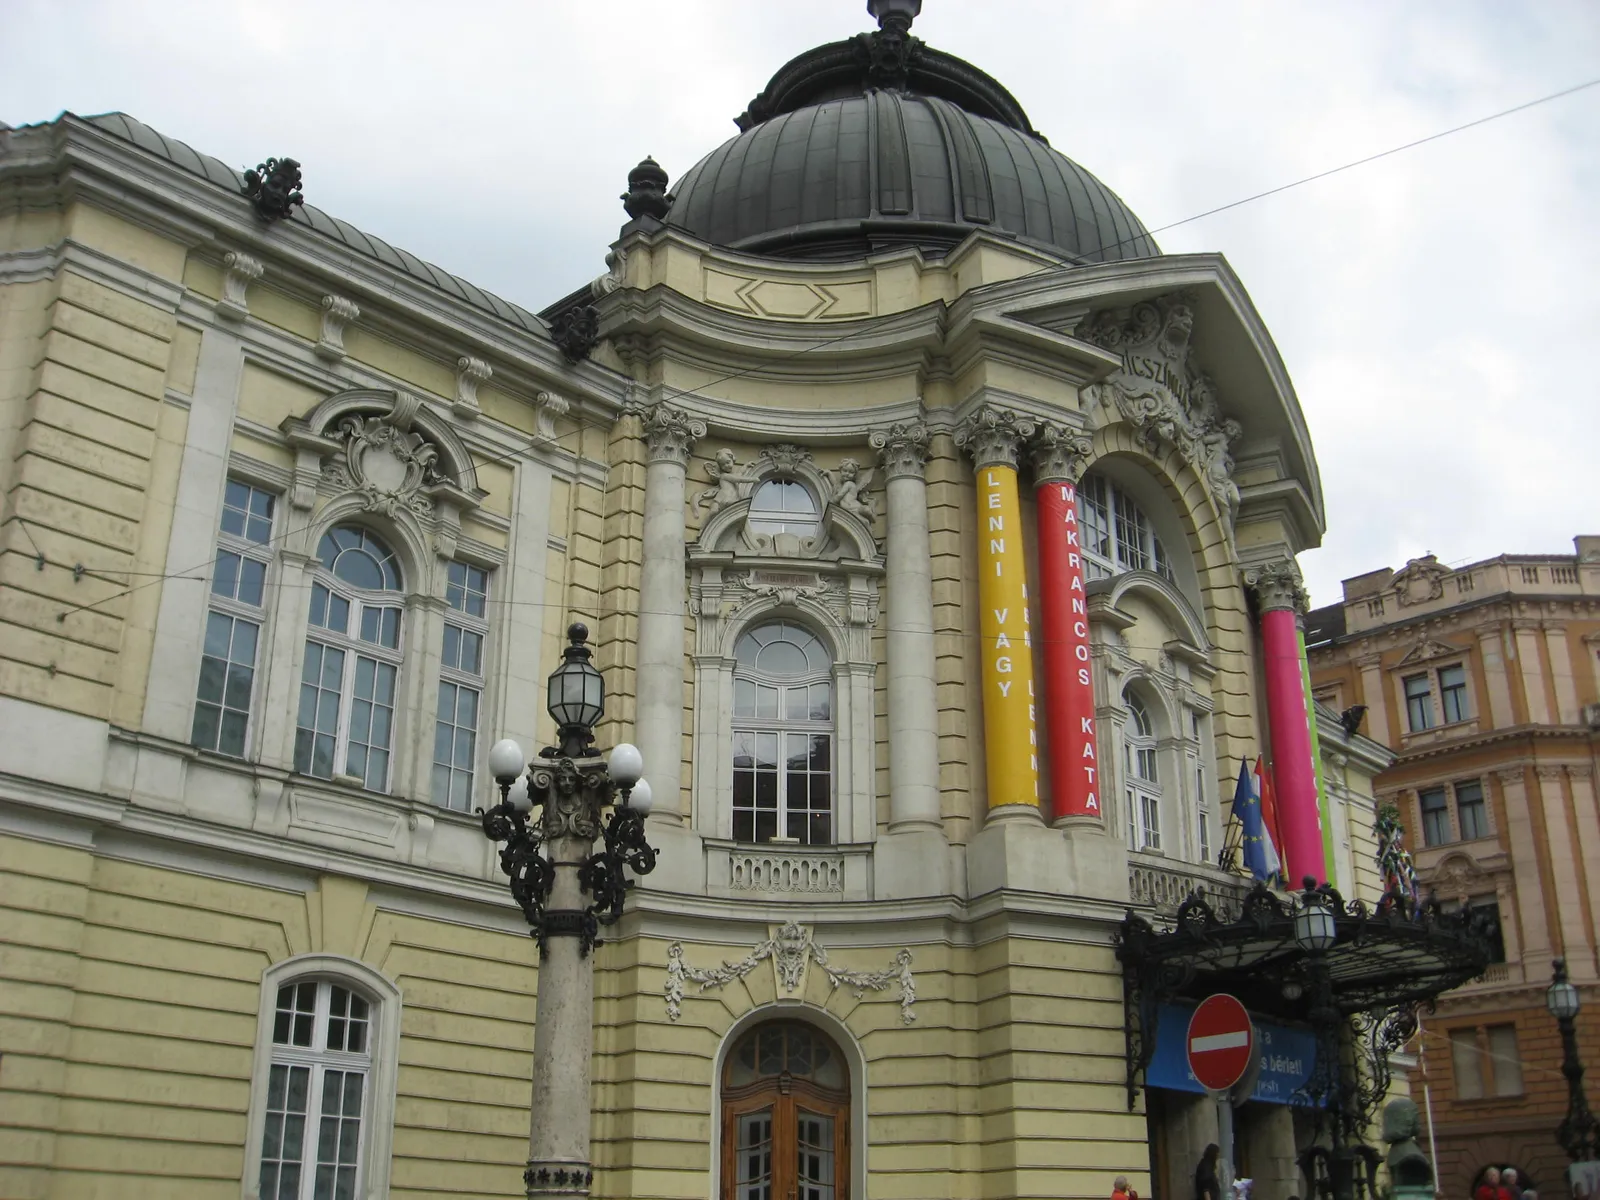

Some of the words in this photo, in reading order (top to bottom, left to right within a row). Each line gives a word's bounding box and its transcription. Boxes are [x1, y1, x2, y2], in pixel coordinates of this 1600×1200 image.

[987, 472, 1005, 577] LENNI
[994, 608, 1012, 698] VAGY
[1061, 486, 1089, 686] MAKRANCOS
[1081, 716, 1097, 810] KATA
[1028, 679, 1039, 797] LENNI
